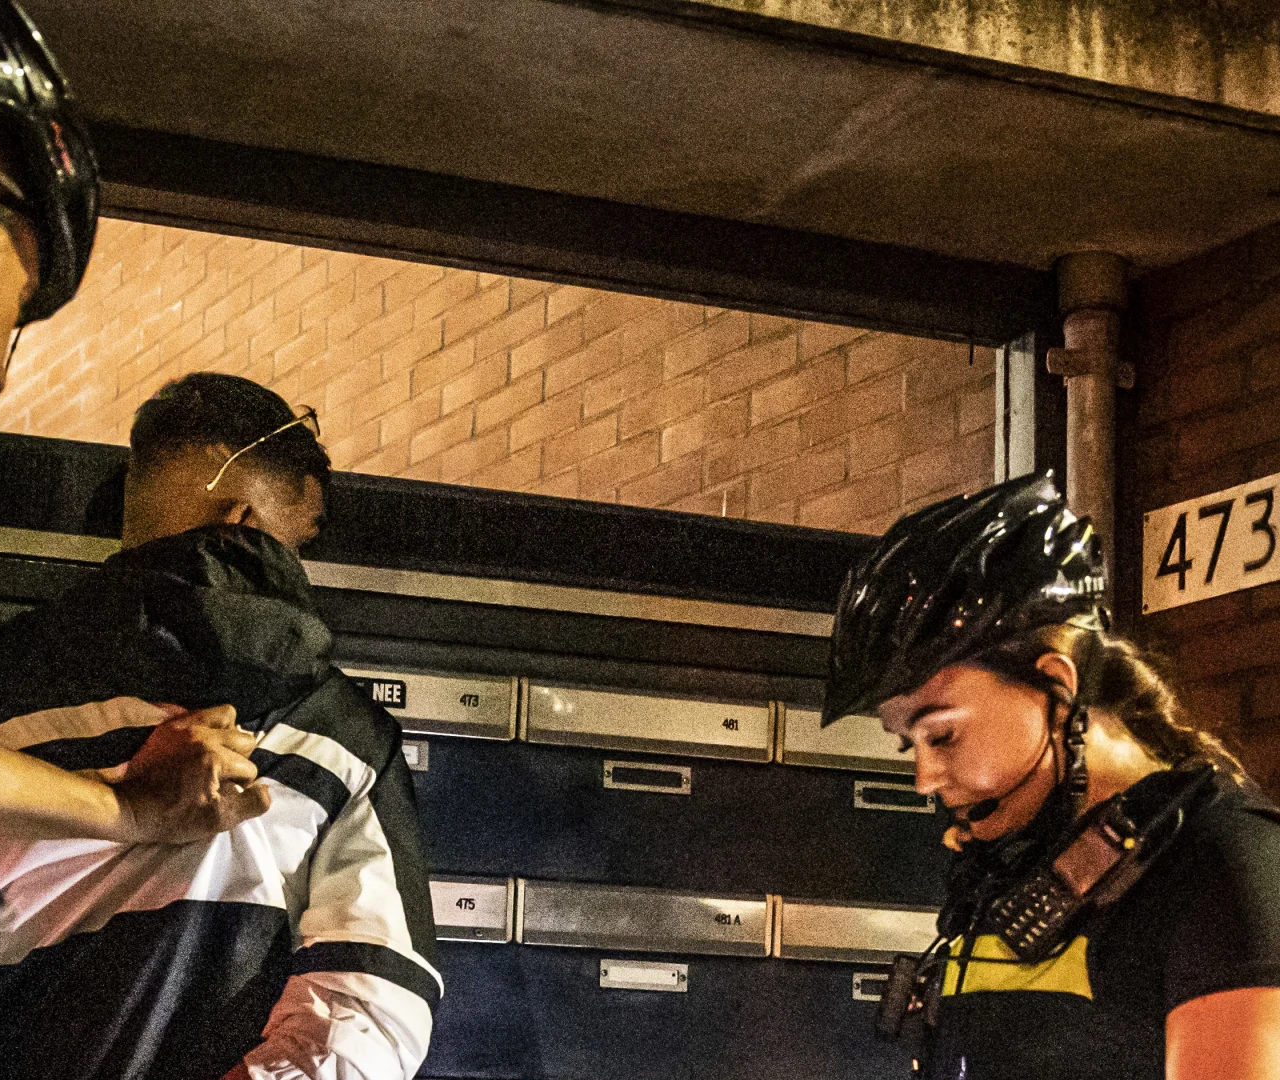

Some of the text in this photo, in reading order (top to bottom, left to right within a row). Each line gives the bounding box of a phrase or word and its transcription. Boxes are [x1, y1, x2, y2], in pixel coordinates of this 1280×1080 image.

[1156, 484, 1277, 592] 473
[372, 682, 401, 703] NEE
[460, 693, 479, 707] 473
[722, 718, 739, 731] 481
[456, 897, 476, 911] 475
